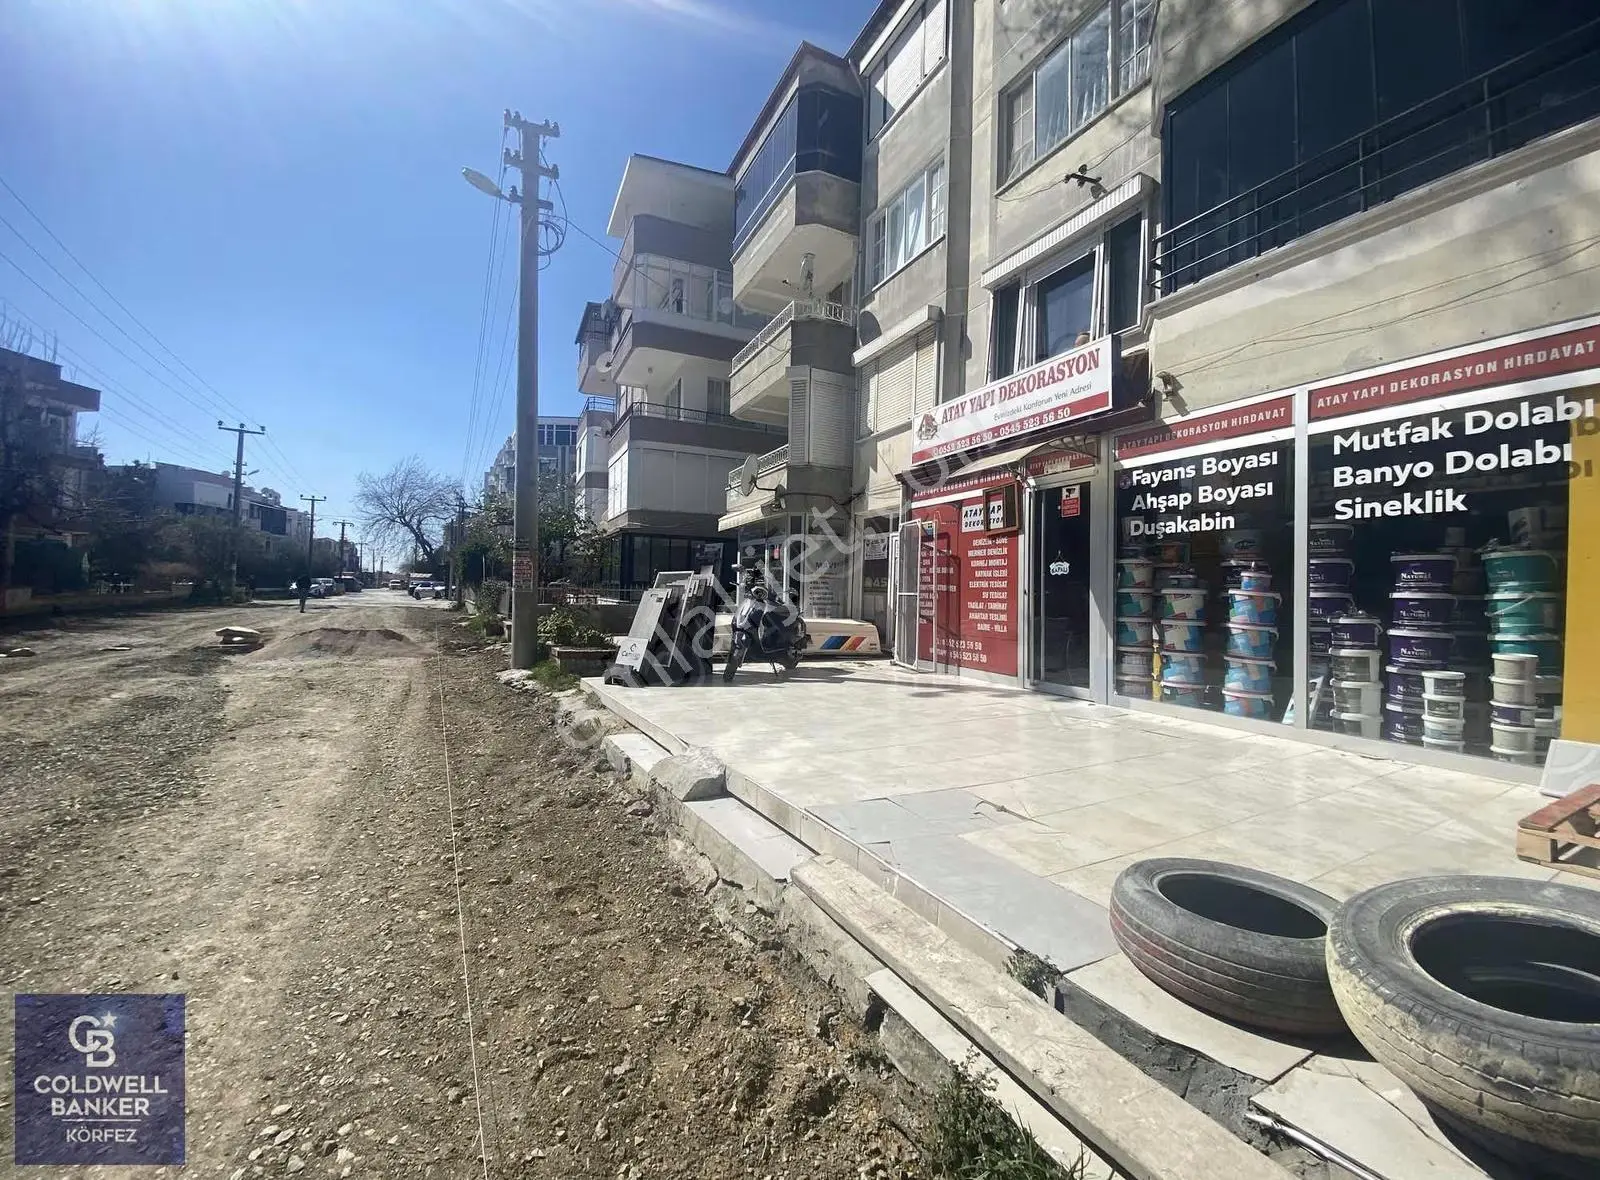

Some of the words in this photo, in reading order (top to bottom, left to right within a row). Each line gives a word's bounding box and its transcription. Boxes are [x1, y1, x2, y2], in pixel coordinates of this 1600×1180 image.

[941, 404, 968, 425] ATAY
[969, 390, 997, 413] YAPI
[999, 348, 1101, 402] DEKORASYON
[1069, 381, 1093, 398] Adresi
[1317, 391, 1349, 409] ATAY
[1352, 384, 1384, 401] YAPI
[1390, 360, 1498, 393] DEKORASYON
[1504, 340, 1596, 370] HIRDAVAT
[999, 422, 1021, 436] 0545
[1022, 417, 1041, 429] 523
[1042, 412, 1056, 424] 56
[1057, 406, 1072, 419] 50
[1231, 407, 1287, 426] HIRDAVAT
[1333, 416, 1454, 456] Mutfak
[1464, 395, 1595, 436] Dolabı
[1132, 463, 1196, 488] Fayans
[1202, 451, 1279, 477] Boyası
[1333, 460, 1434, 488] Banyo
[1445, 438, 1573, 476] Dolabı
[964, 508, 984, 518] ATAY
[1131, 491, 1192, 513] Ahşap
[1198, 481, 1274, 505] Boyası
[1334, 488, 1469, 521] Sineklik
[1130, 512, 1236, 540] Duşakabin
